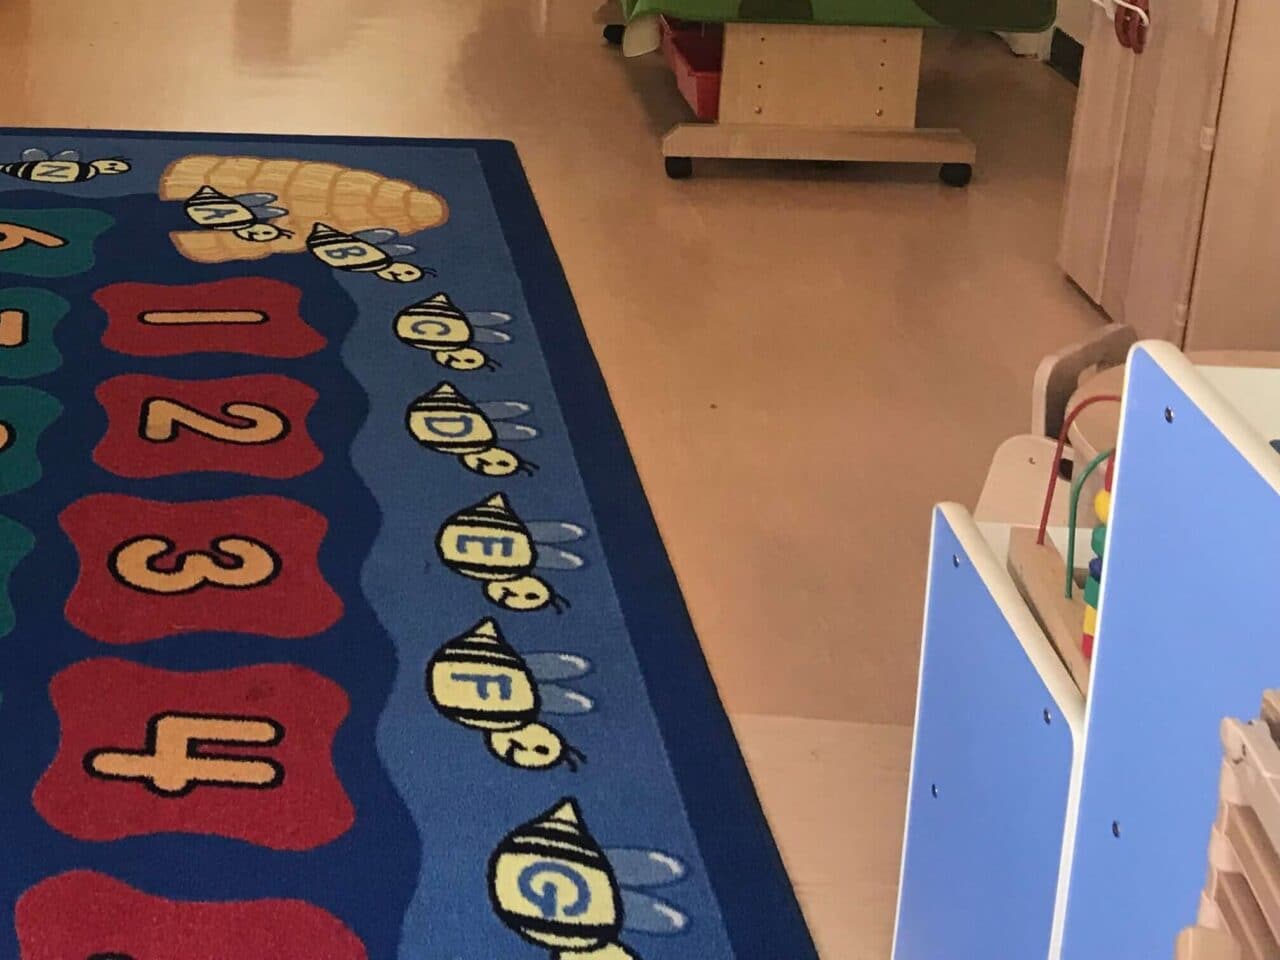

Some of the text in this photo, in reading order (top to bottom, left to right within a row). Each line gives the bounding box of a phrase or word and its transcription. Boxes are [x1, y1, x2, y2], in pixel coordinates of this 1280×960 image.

[194, 208, 238, 221] A
[324, 245, 368, 259] B
[411, 320, 451, 336] C
[138, 396, 291, 445] 2
[424, 415, 473, 437] D
[456, 533, 514, 557] E
[107, 534, 282, 596] 3
[451, 673, 512, 700] F
[84, 709, 285, 797] 4
[517, 861, 592, 917] G
